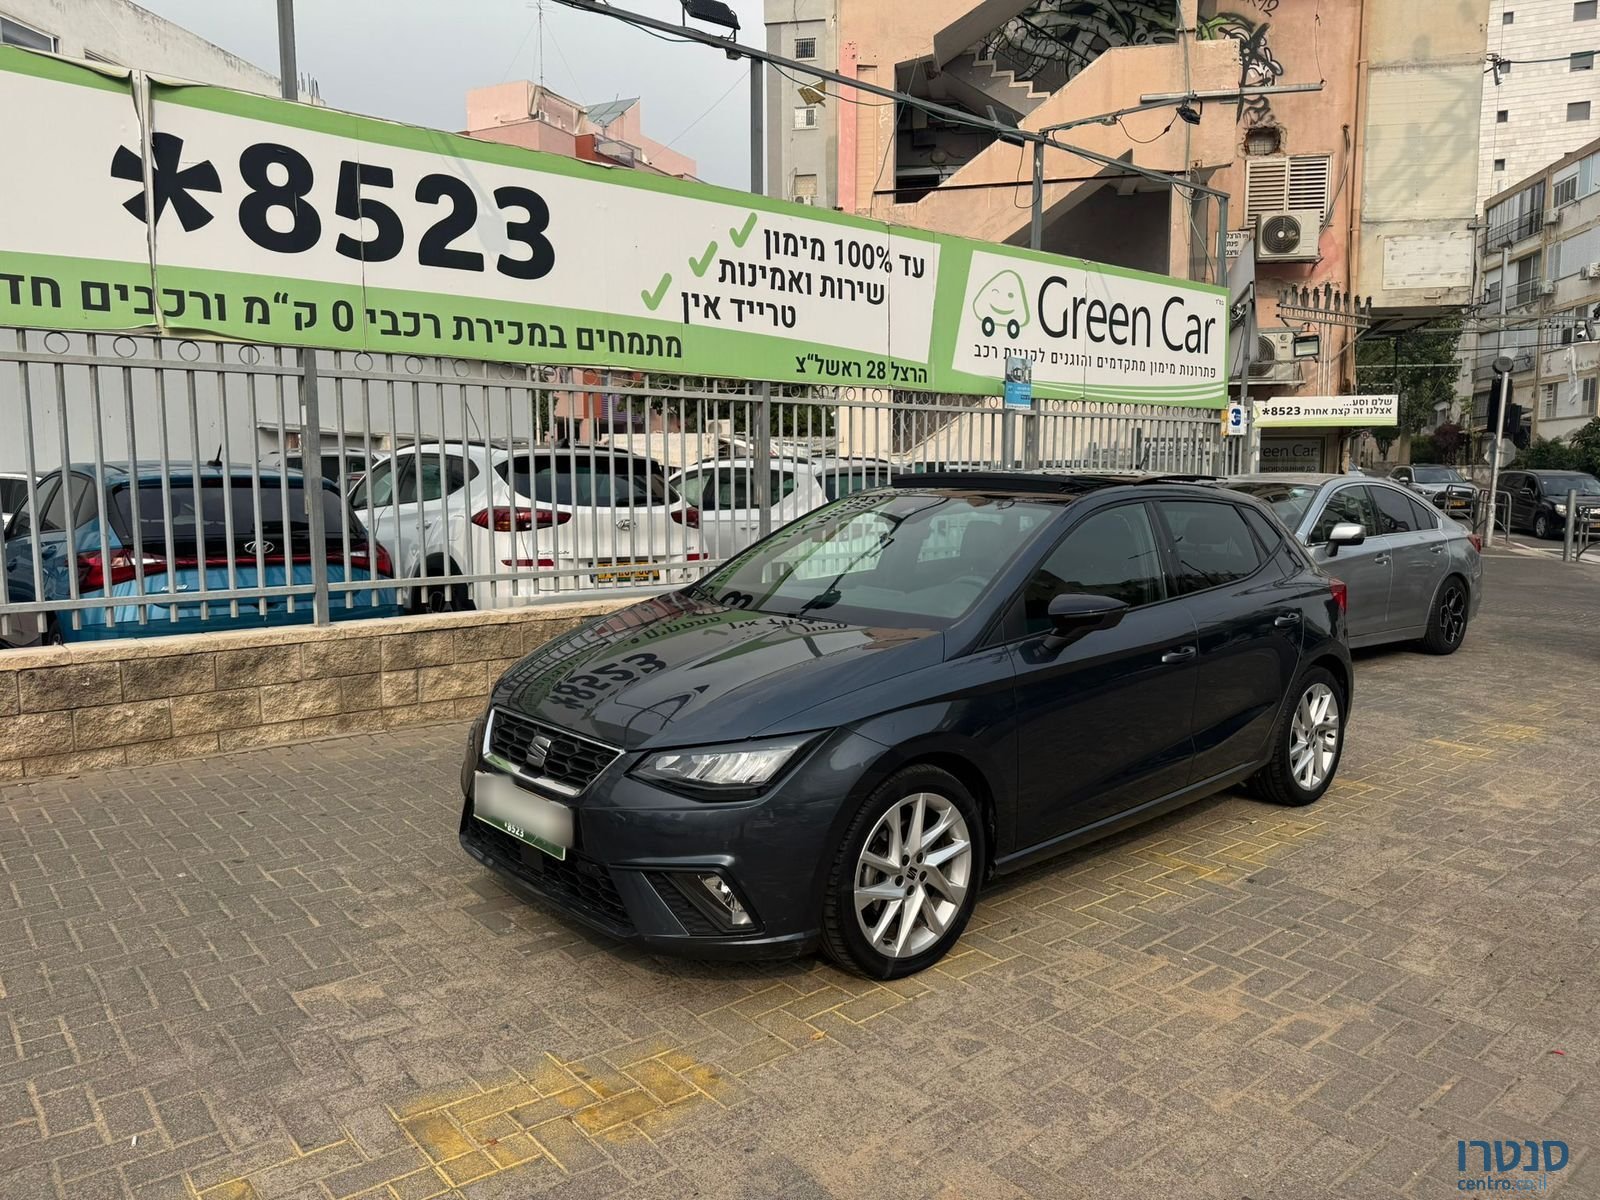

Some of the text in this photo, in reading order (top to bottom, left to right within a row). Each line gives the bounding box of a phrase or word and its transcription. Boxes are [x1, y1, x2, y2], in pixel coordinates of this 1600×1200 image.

[764, 229, 925, 279] עד 100% מימון
[718, 258, 884, 305] שירות ואמינות
[81, 280, 227, 321] ורכבים
[243, 291, 318, 331] ק"מ
[681, 291, 796, 328] טרייד אין
[332, 300, 354, 332] 0
[366, 308, 441, 339] רכבי
[1038, 276, 1216, 354] Green Car
[453, 316, 567, 349] במכירת
[576, 327, 682, 358] מתמחים
[974, 344, 998, 359] רכב
[1051, 351, 1092, 367] והוגנים
[796, 353, 928, 383] הרצל 28 ראשל"צ
[1097, 356, 1146, 373] מתקדמים
[1150, 361, 1176, 376] מימון
[1179, 364, 1216, 378] פתרונות
[1304, 407, 1329, 415] אחרת
[1331, 407, 1351, 416] קצת
[1353, 407, 1364, 415] זה
[1366, 406, 1392, 415] אצלנו
[1371, 397, 1393, 406] שלם
[1292, 443, 1317, 457] Car
